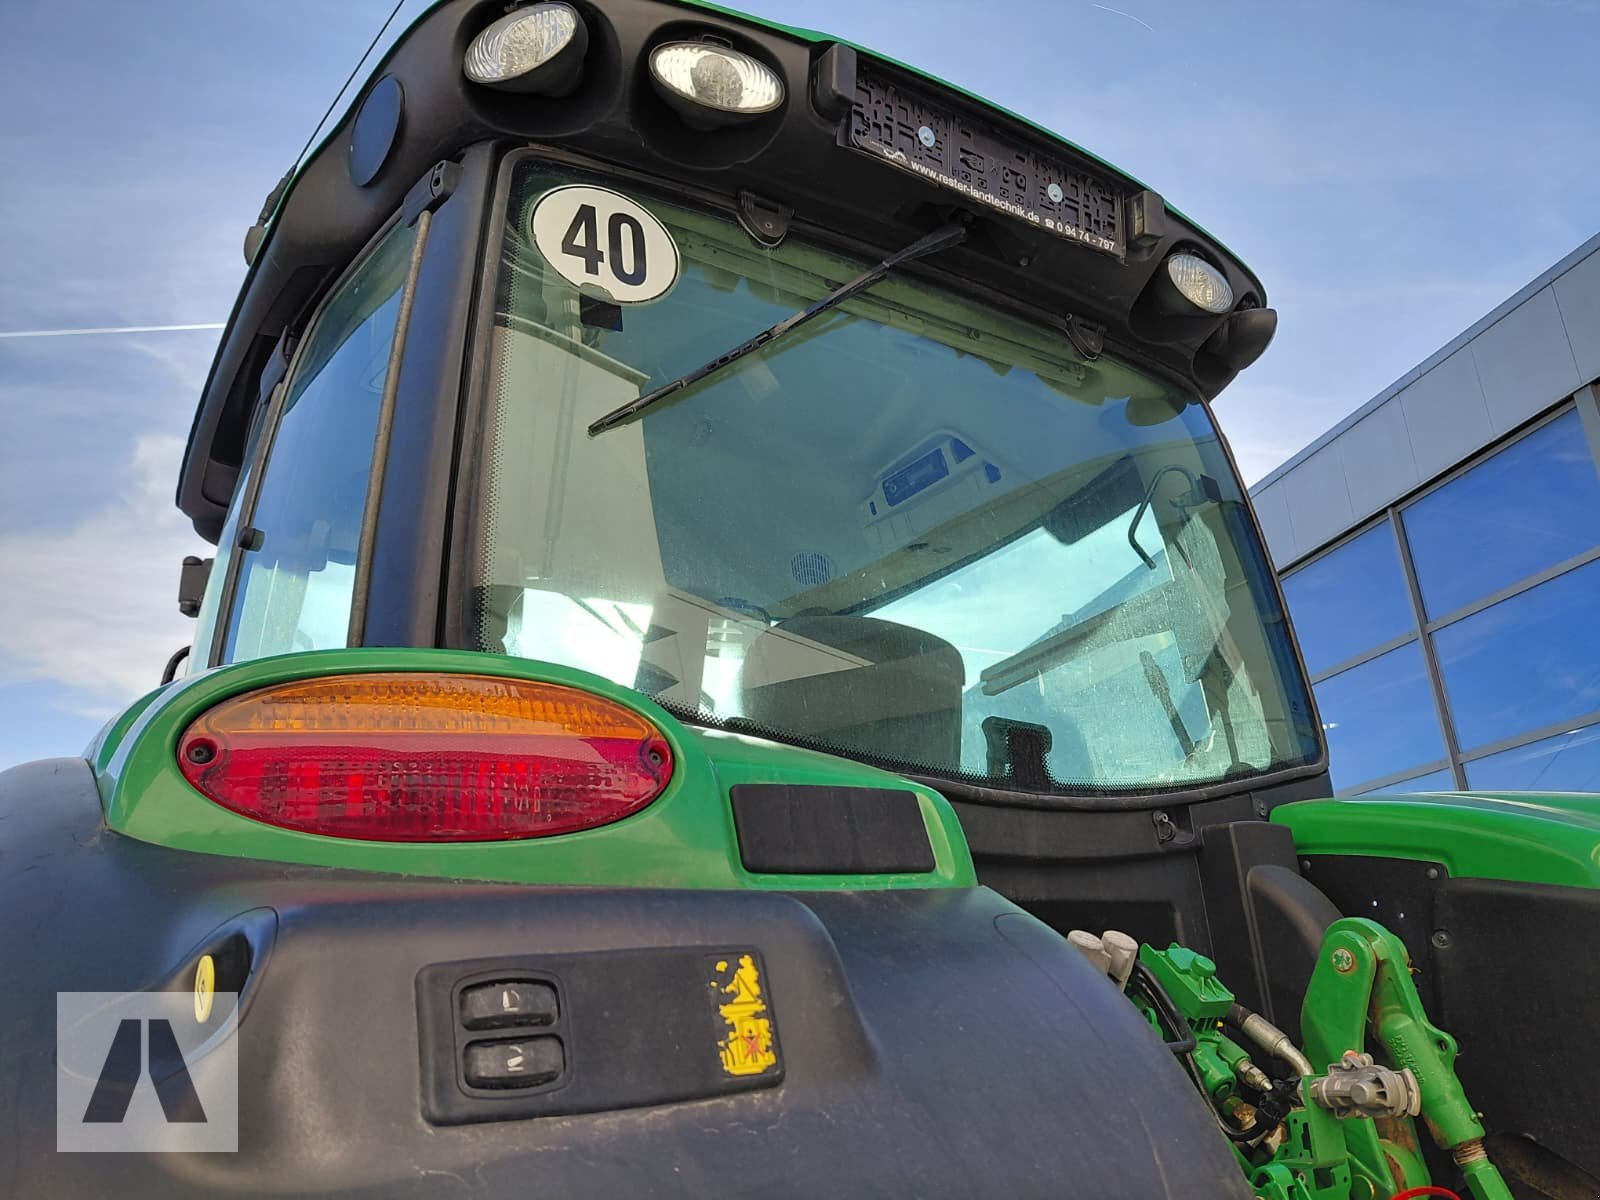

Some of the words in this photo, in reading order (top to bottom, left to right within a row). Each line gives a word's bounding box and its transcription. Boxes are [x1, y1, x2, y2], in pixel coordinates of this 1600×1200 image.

[561, 203, 647, 287] 40
[911, 161, 1039, 222] www.rester-landtechnik.de
[1057, 222, 1063, 232] 0
[1065, 225, 1076, 237] 94
[1079, 231, 1090, 242] 74
[1099, 237, 1115, 250] 797
